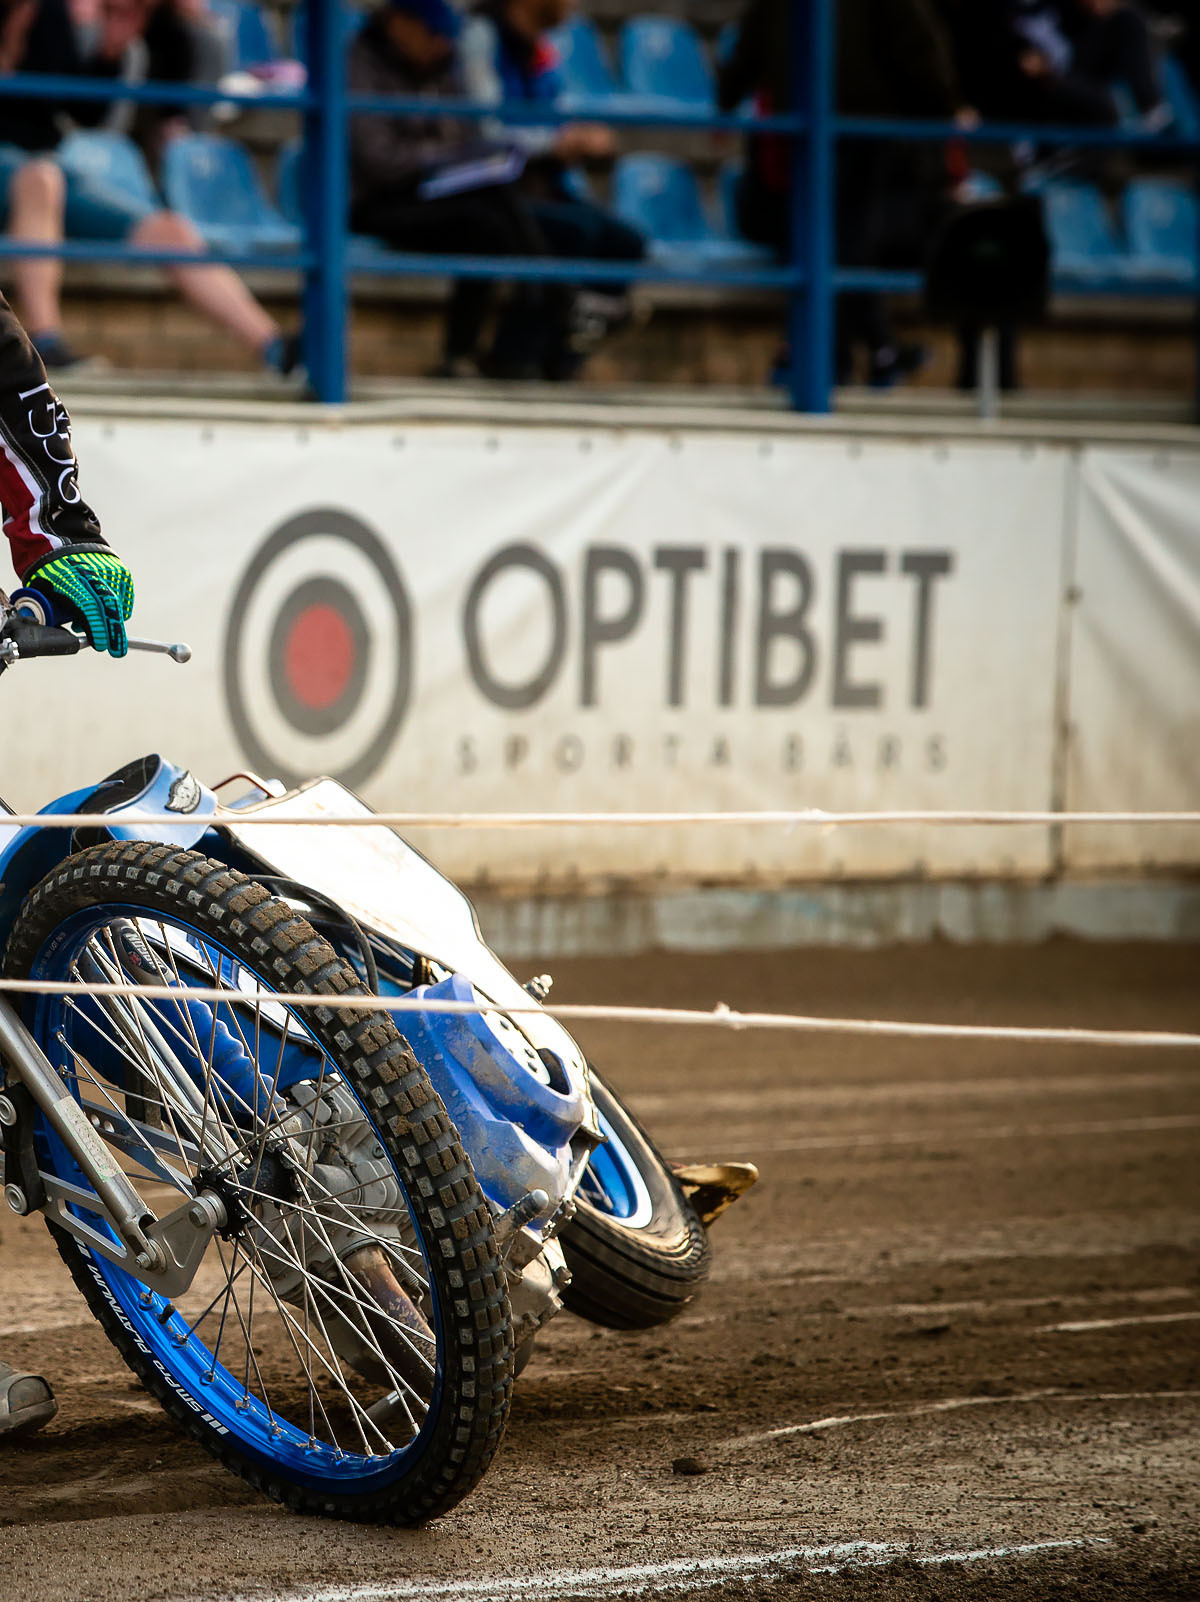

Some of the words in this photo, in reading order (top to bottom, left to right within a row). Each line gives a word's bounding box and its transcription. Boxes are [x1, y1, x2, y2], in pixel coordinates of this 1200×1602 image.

[462, 541, 954, 711] OPTIBET
[456, 733, 731, 776] SPORTA
[86, 1263, 152, 1354] PLATINUM
